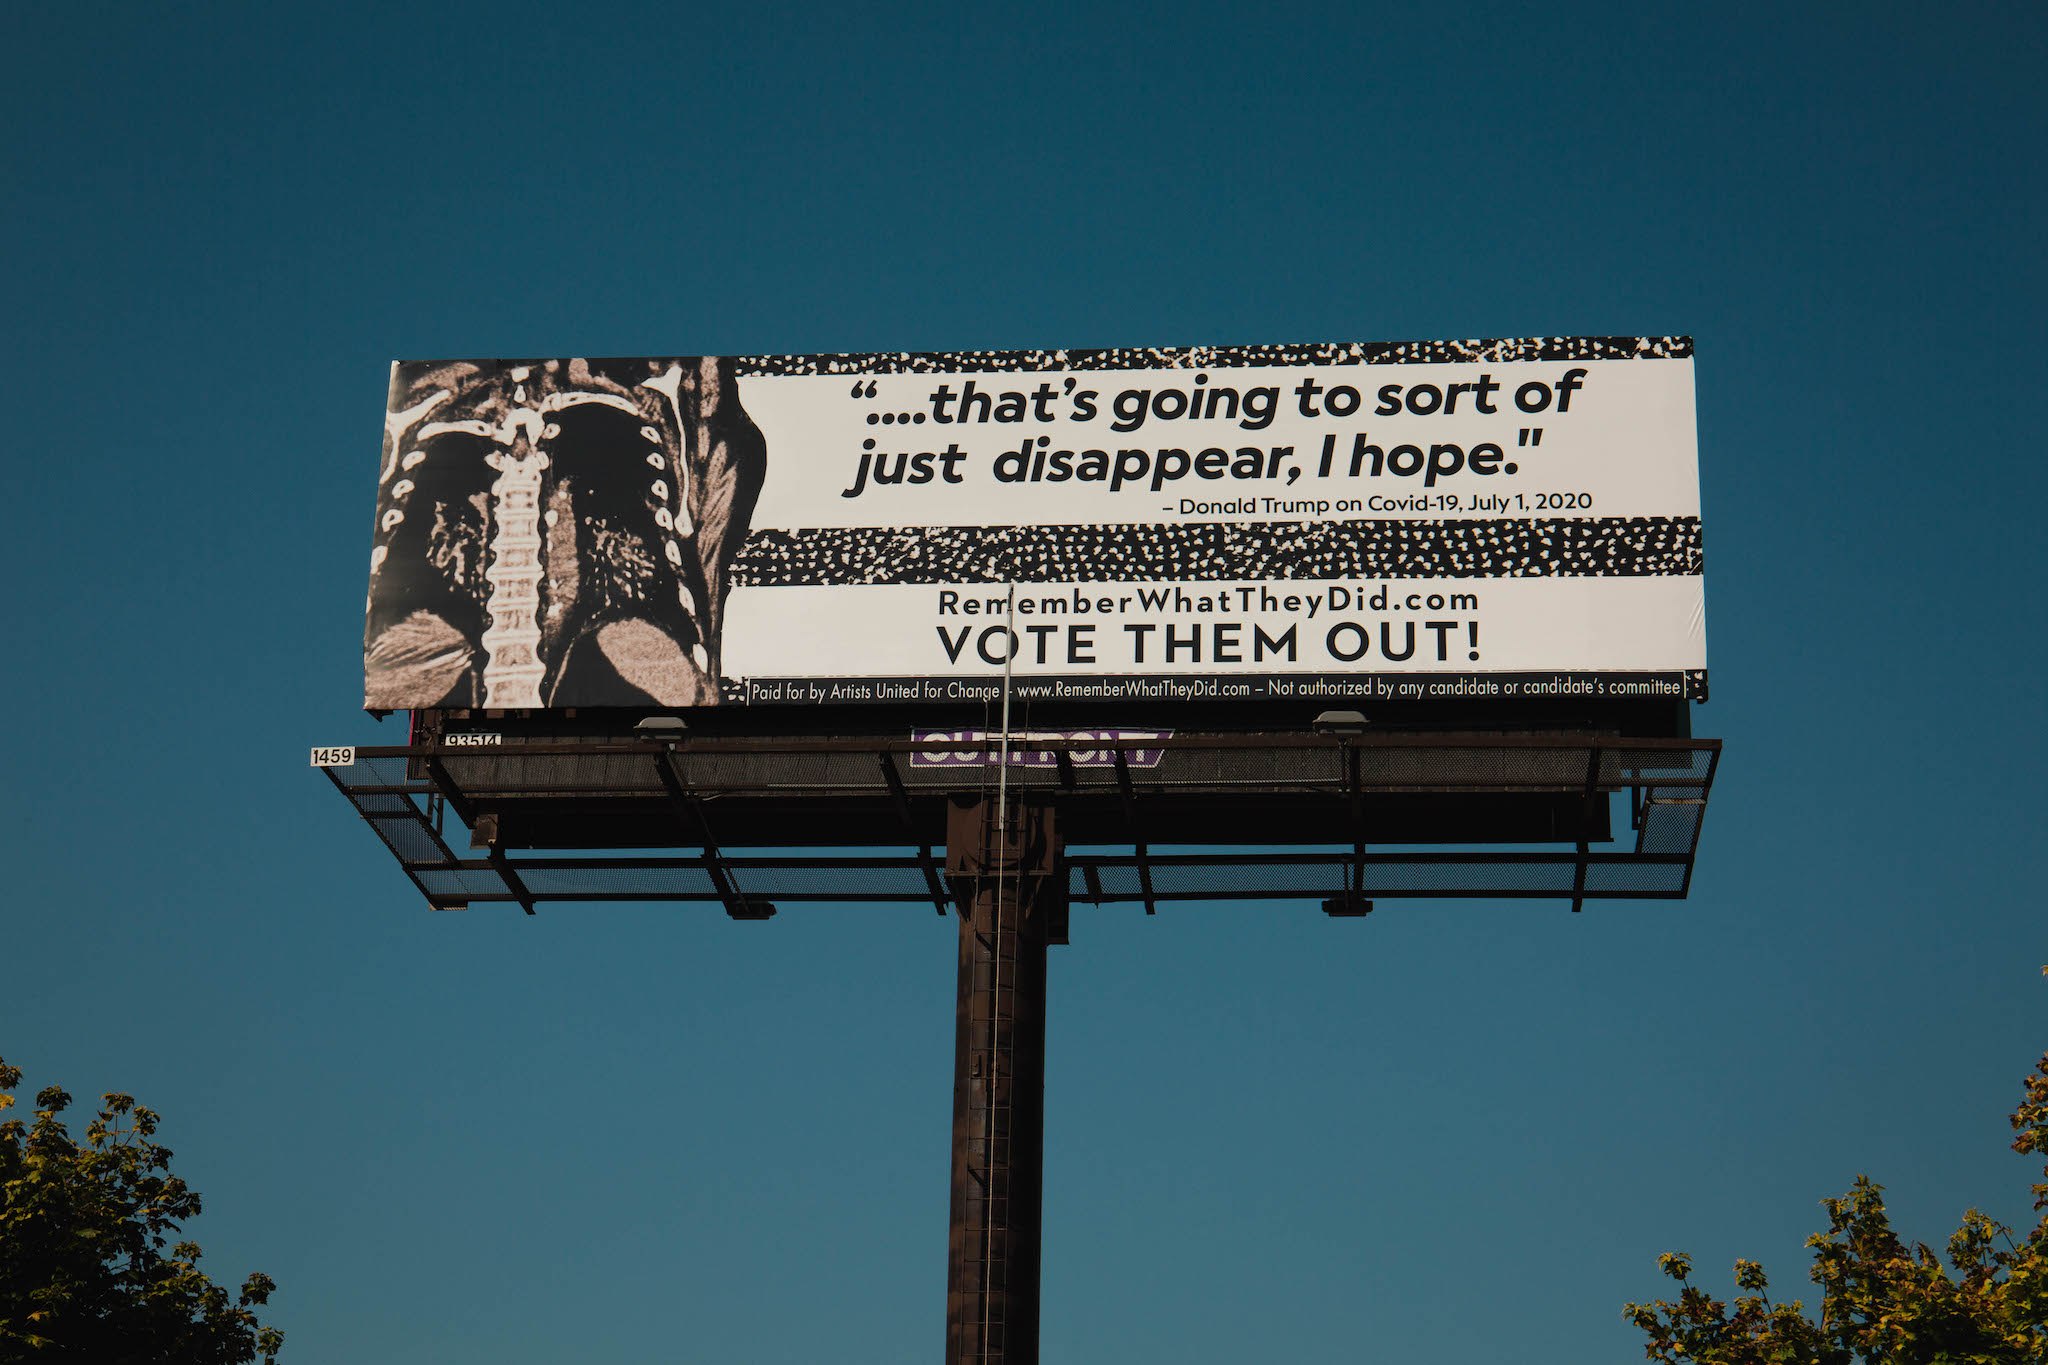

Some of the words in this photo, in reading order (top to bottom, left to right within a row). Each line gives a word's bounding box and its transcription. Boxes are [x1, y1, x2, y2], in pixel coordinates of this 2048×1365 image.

[1110, 373, 1280, 432] going
[1294, 377, 1361, 419] to
[1374, 374, 1501, 415] sort
[1514, 367, 1589, 413] of
[840, 438, 968, 499] just
[993, 434, 1302, 493] disappear,
[1318, 433, 1337, 478] I
[1180, 496, 1256, 515] Donald
[1261, 495, 1330, 514] Trump
[1336, 499, 1362, 512] on
[1367, 492, 1464, 513] Covid-19,
[1468, 490, 1511, 513] July
[1514, 492, 1531, 511] 1,
[1535, 491, 1594, 510] 2020
[938, 584, 1480, 618] RememberWhatTheyDid.com
[936, 624, 1097, 666] VOTE
[1123, 622, 1298, 664] THEM
[1325, 620, 1481, 662] OUT!
[752, 683, 782, 700] Paid
[786, 682, 805, 700] for
[809, 682, 826, 704] by
[830, 682, 871, 699] Artists
[876, 681, 920, 699] United
[924, 681, 943, 698] for
[947, 682, 1000, 702] Change
[1017, 679, 1250, 701] www.RememberWhatTheyDid.com
[1268, 679, 1295, 696] Not
[1298, 678, 1372, 696] authorized
[1377, 677, 1395, 700] by
[1399, 681, 1425, 700] any
[1429, 676, 1499, 696] candidate
[1503, 682, 1518, 694] or
[1609, 678, 1681, 695] committee
[313, 749, 352, 764] 1459
